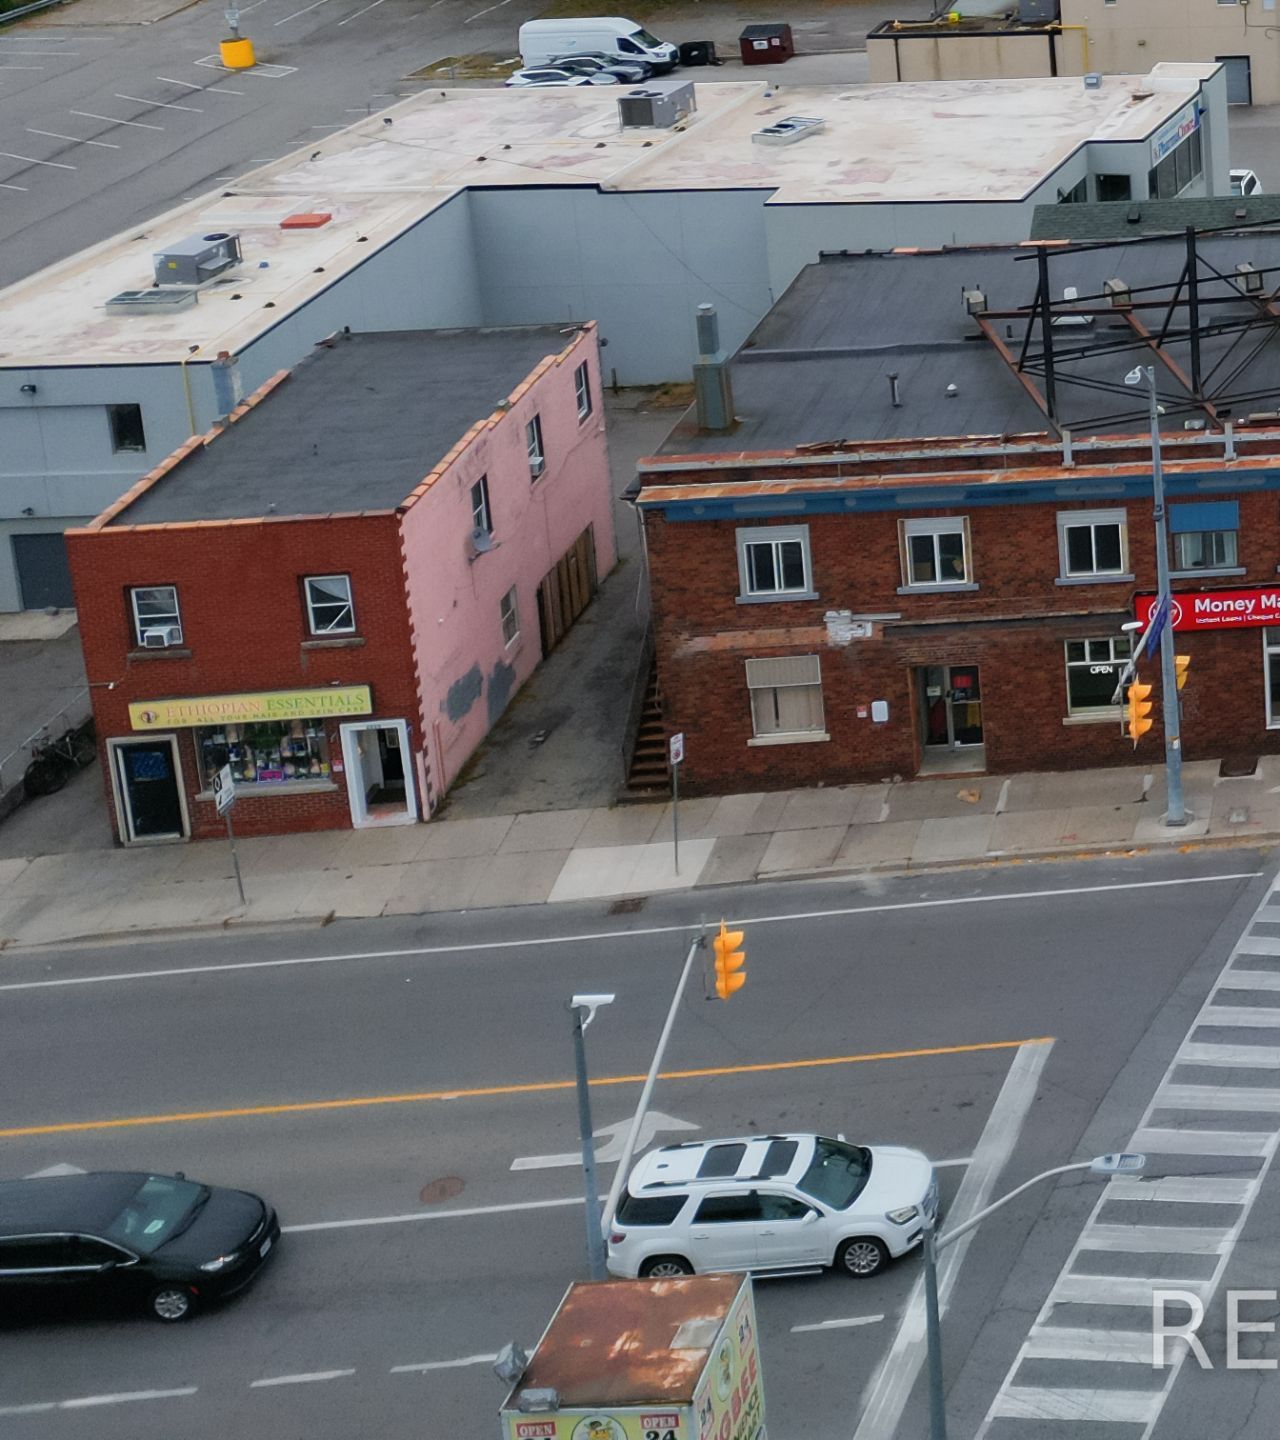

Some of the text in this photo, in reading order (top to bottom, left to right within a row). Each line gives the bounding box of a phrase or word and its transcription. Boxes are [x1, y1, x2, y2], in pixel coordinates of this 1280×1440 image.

[1194, 598, 1256, 614] Money
[1090, 665, 1113, 674] OPEN
[167, 693, 365, 718] ETHIOPIAN ESSENTIALS
[644, 1417, 676, 1427] OPEN
[519, 1425, 553, 1436] OPEN
